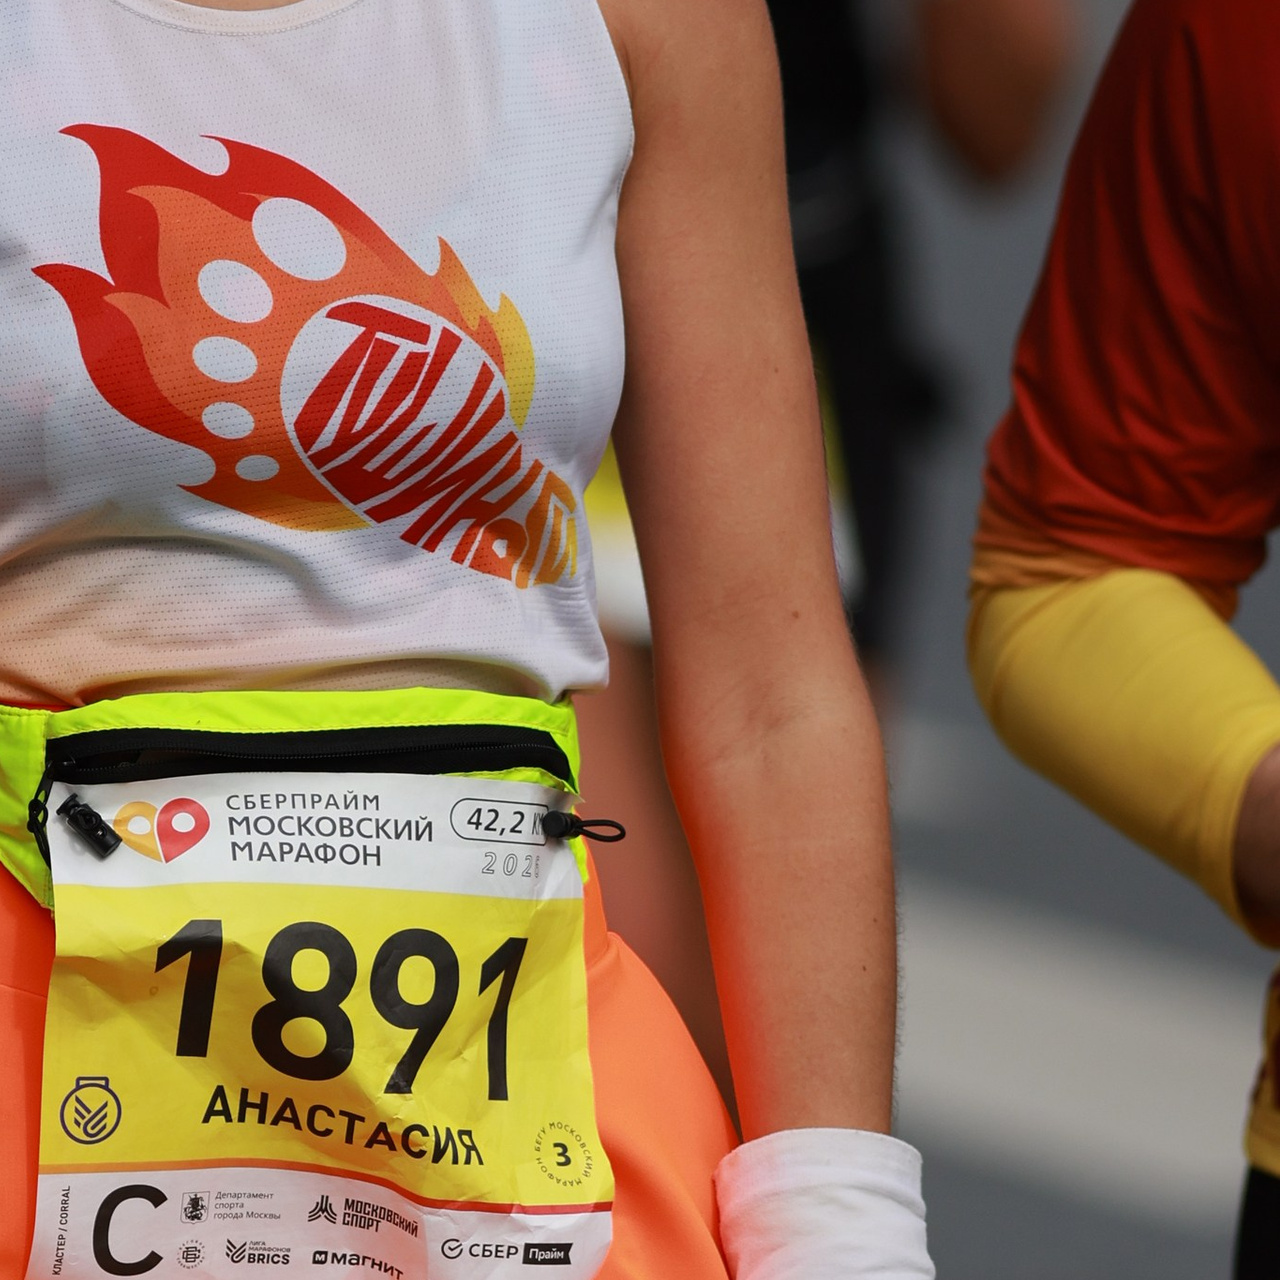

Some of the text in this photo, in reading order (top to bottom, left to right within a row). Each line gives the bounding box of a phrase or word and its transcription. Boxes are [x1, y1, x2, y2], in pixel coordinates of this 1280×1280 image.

[225, 790, 381, 812] СБЕРПРАЙМ
[228, 815, 434, 842] МОСКОВСКИЙ
[467, 807, 525, 836] 42,2
[230, 841, 382, 867] МАРАФОН
[154, 919, 529, 1101] 1891
[201, 1084, 485, 1166] АНАСТАСИЯ
[552, 1142, 572, 1167] 3
[214, 1191, 274, 1200] Департамент
[214, 1202, 244, 1210] спорта
[213, 1211, 281, 1220] города Москвы
[342, 1211, 382, 1233] СПОРТ
[344, 1198, 418, 1238] МОСКОВСКИЙ
[52, 1233, 66, 1276] КЛАСТЕР
[59, 1185, 71, 1226] CORRAL
[92, 1184, 168, 1276] C
[247, 1253, 290, 1265] BRICS
[468, 1243, 564, 1262] СБЕР Прайм
[331, 1252, 404, 1280] магнит
